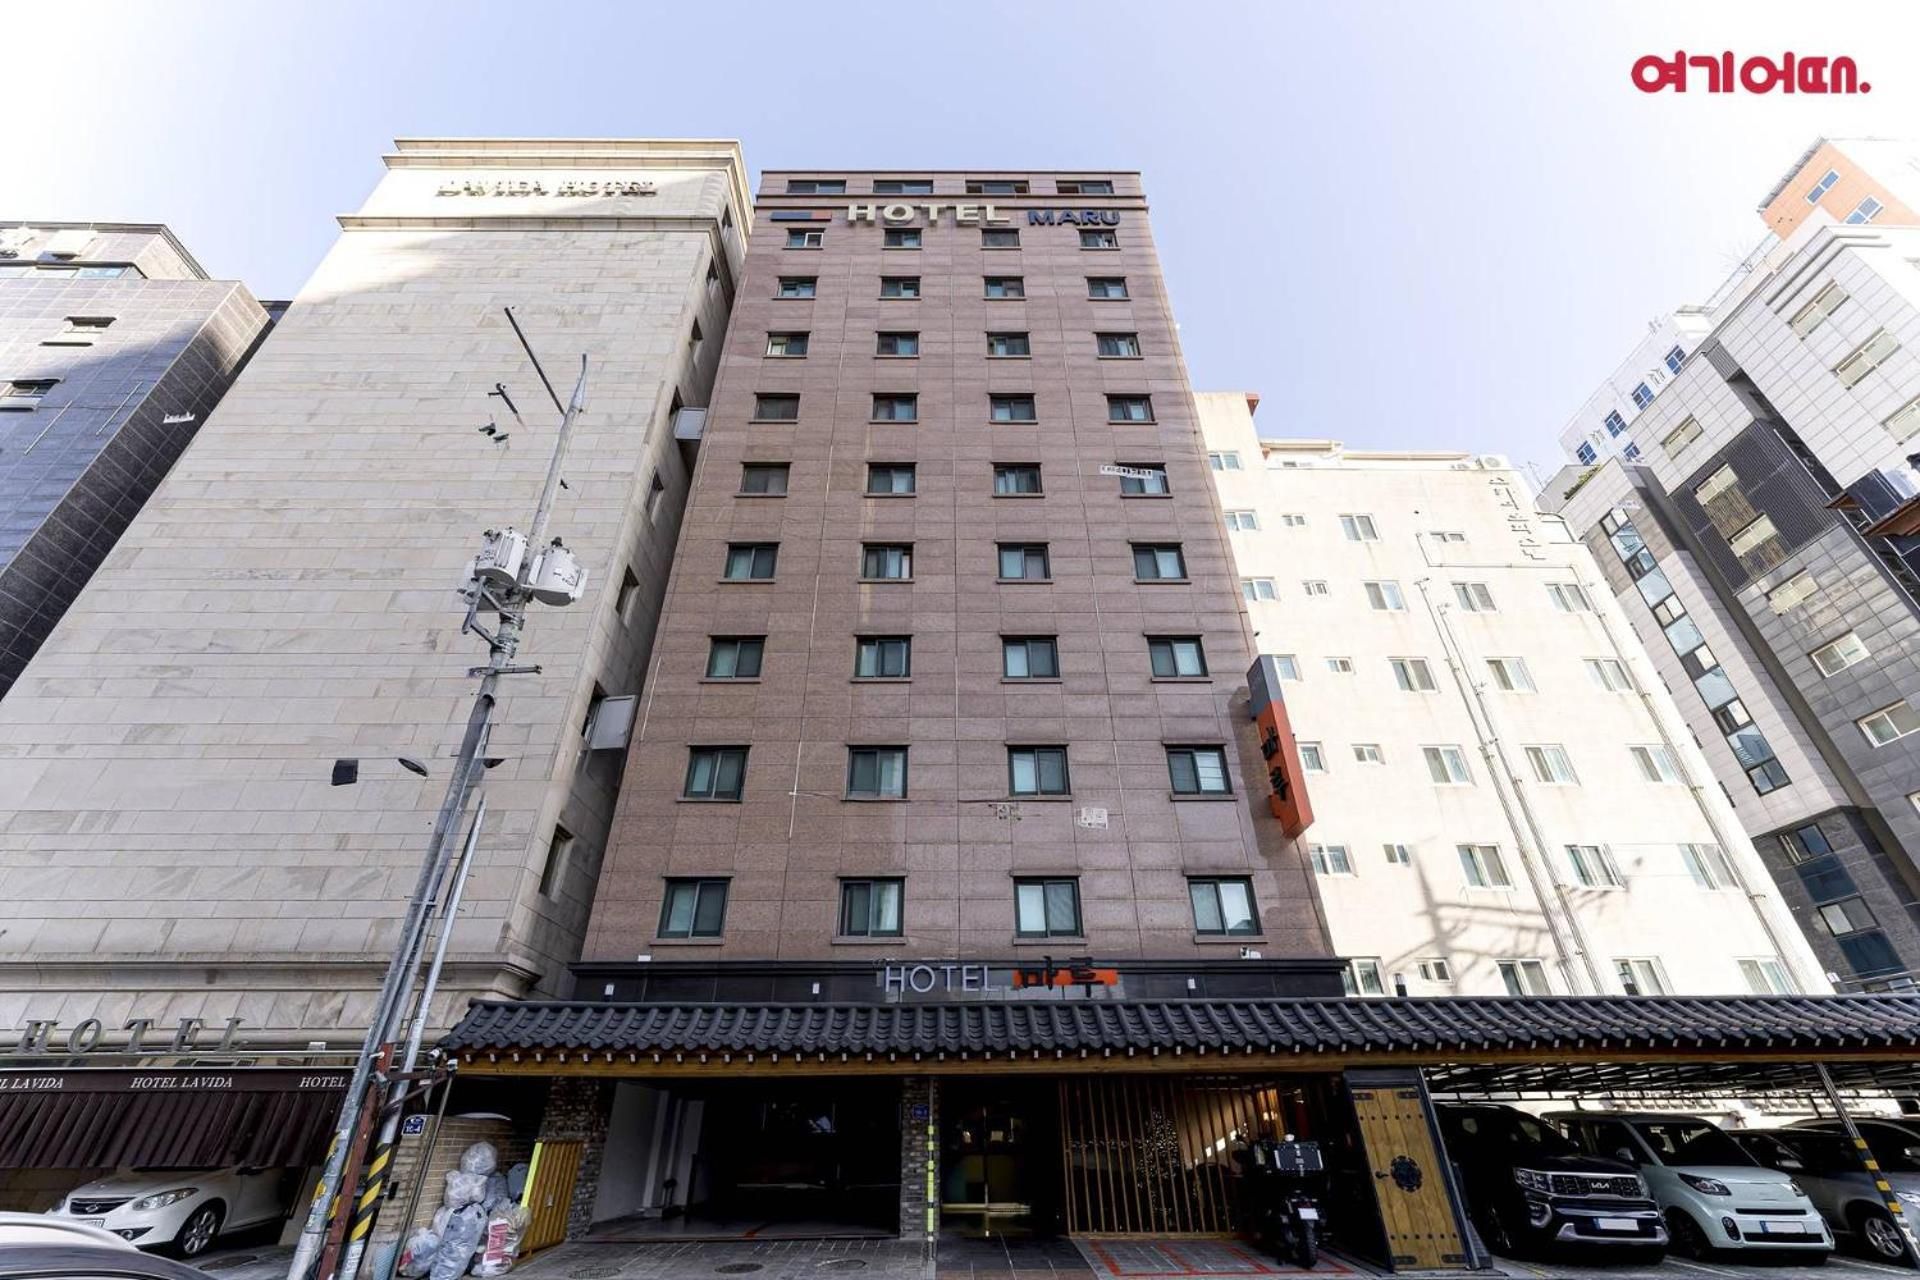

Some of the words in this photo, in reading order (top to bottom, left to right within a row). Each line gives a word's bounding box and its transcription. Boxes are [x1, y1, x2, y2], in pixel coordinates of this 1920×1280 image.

[554, 180, 657, 197] HOTEL
[847, 203, 1010, 226] HOTEL
[1027, 208, 1121, 226] MARU
[885, 965, 1000, 993] HOTEL
[1018, 955, 1104, 998] 마루
[16, 1018, 248, 1054] HOTEL
[11, 1077, 64, 1089] LAVIDA
[130, 1077, 177, 1089] HOTEL
[181, 1076, 233, 1088] LAVIDA
[299, 1076, 347, 1088] HOTEL
